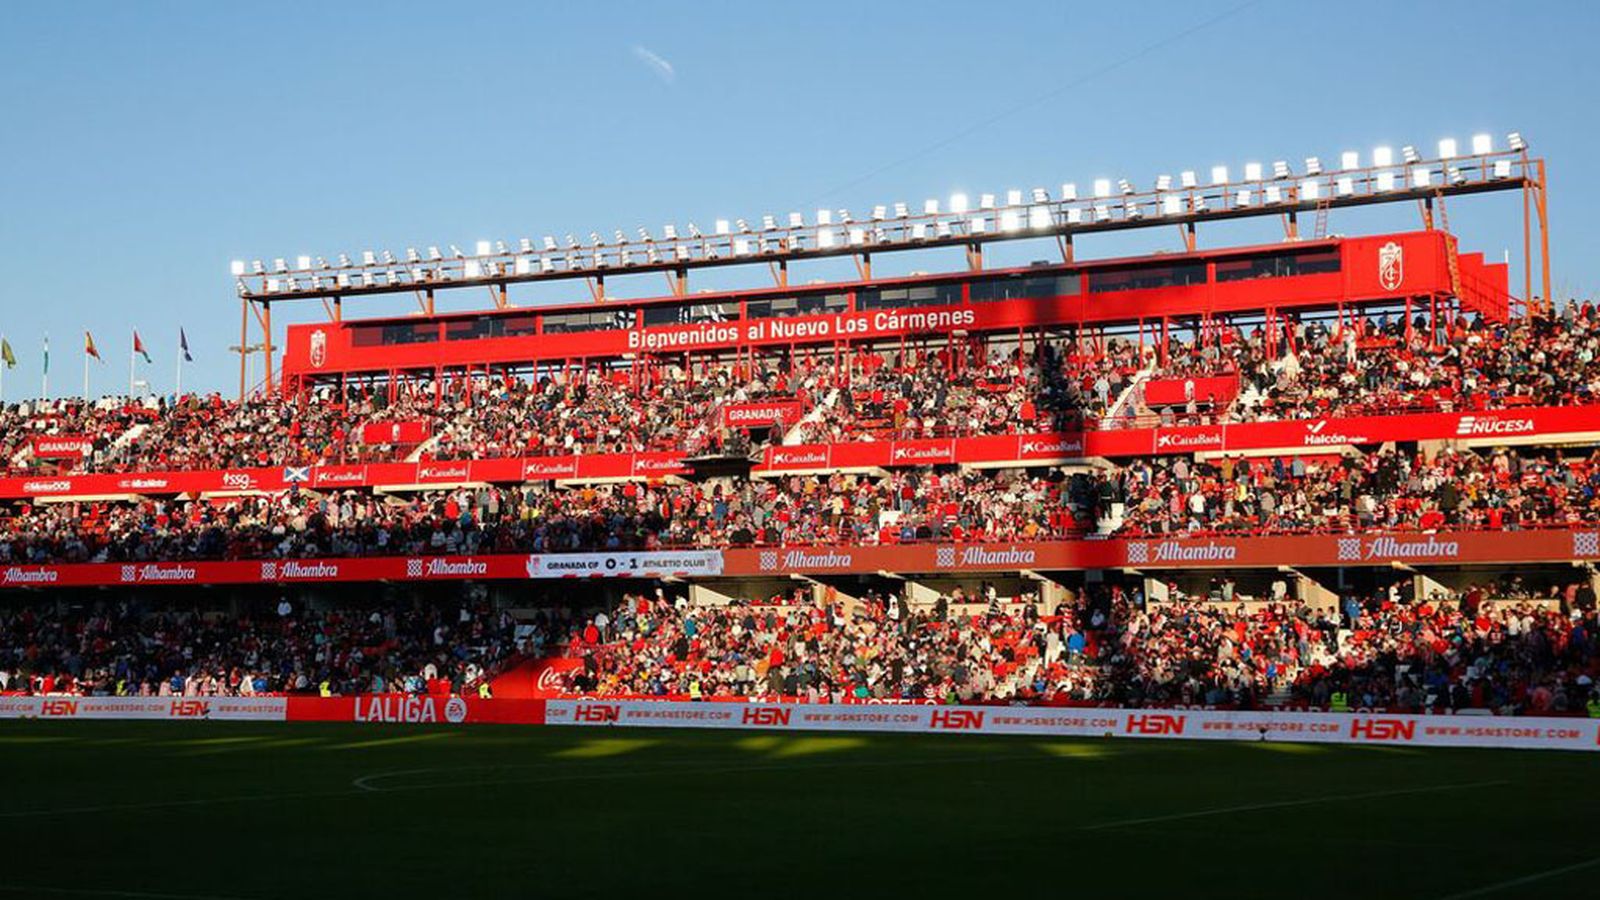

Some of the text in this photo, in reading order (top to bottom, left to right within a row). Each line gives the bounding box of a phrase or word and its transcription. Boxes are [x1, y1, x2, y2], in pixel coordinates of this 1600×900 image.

[628, 309, 975, 348] Bienvenidos al Nuevo Los Cármenes
[729, 408, 781, 420] GRANADA
[1172, 434, 1221, 446] CaixaBank
[1304, 432, 1347, 445] Halcón
[907, 447, 949, 459] CaixaBank
[1034, 441, 1082, 453] CaixaBank
[785, 453, 826, 464] CaixaBank
[430, 468, 465, 477] CaixaBank
[537, 464, 573, 474] CaixaBank
[1153, 543, 1236, 562] Alhambra
[1366, 538, 1458, 559] Alhambra
[547, 562, 586, 570] GRANADA
[605, 559, 616, 569] 0
[629, 558, 638, 569] 1
[781, 552, 851, 569] Alhambra
[961, 548, 1035, 566] Alhambra
[2, 568, 57, 583] Alhambra
[139, 566, 195, 581] Alhambra
[278, 563, 338, 578] Alhambra
[427, 560, 486, 576] Alhambra
[41, 701, 77, 715] HSN
[170, 701, 210, 716] HSN
[354, 697, 436, 723] LALIGA
[574, 704, 621, 723] HSN
[742, 706, 791, 726] HSN
[930, 709, 984, 730] HSN
[991, 716, 1117, 728] WWW.HSNSTORE.COM
[1125, 714, 1186, 735] HSN
[1350, 718, 1416, 741] HSN
